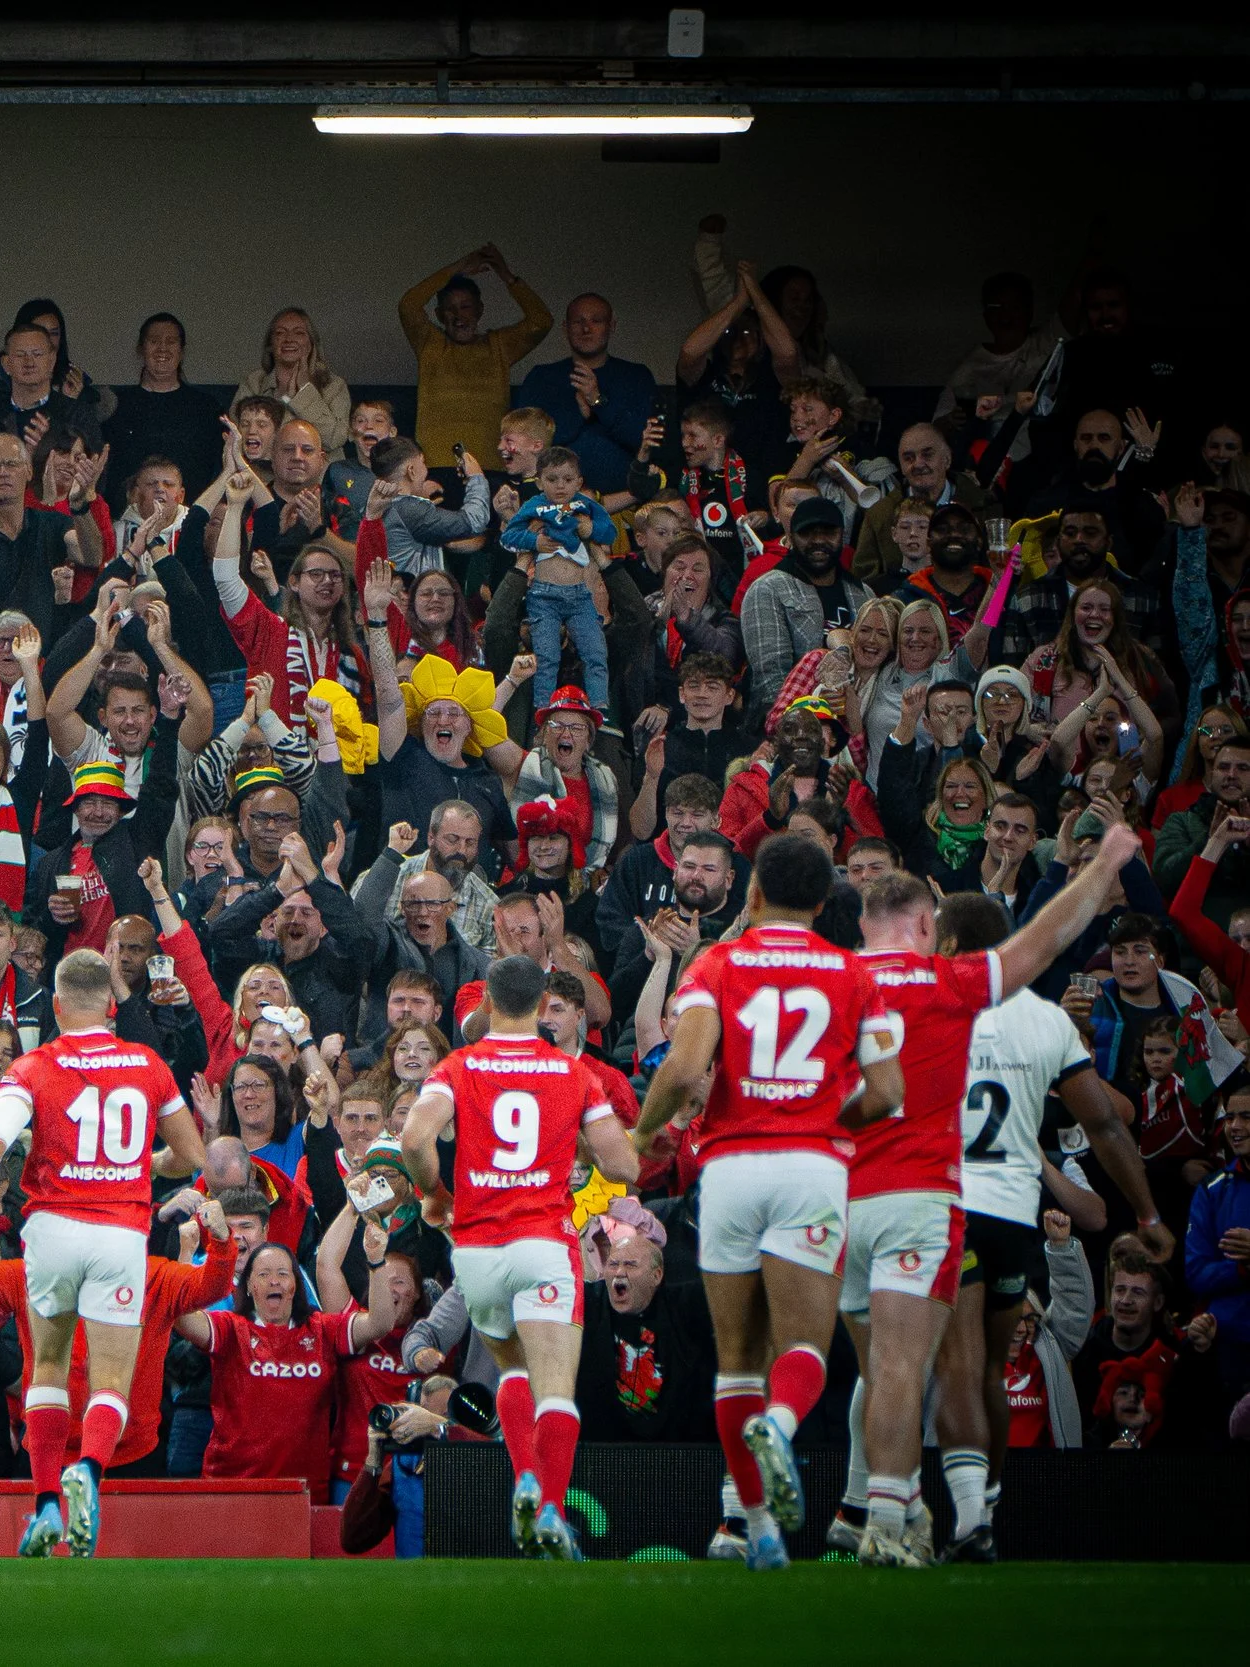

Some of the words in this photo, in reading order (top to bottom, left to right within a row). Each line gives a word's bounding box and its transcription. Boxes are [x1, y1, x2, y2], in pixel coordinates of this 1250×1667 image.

[737, 985, 832, 1081] 12
[57, 1055, 148, 1070] GO.COMPARE
[465, 1056, 569, 1074] GO.COMPARE
[741, 1080, 818, 1100] THOMAS
[66, 1087, 148, 1164] 10
[492, 1091, 540, 1171] 9
[60, 1165, 142, 1181] ANSCOMBE
[469, 1171, 550, 1188] WILLIAMS
[250, 1362, 321, 1377] CAZOO
